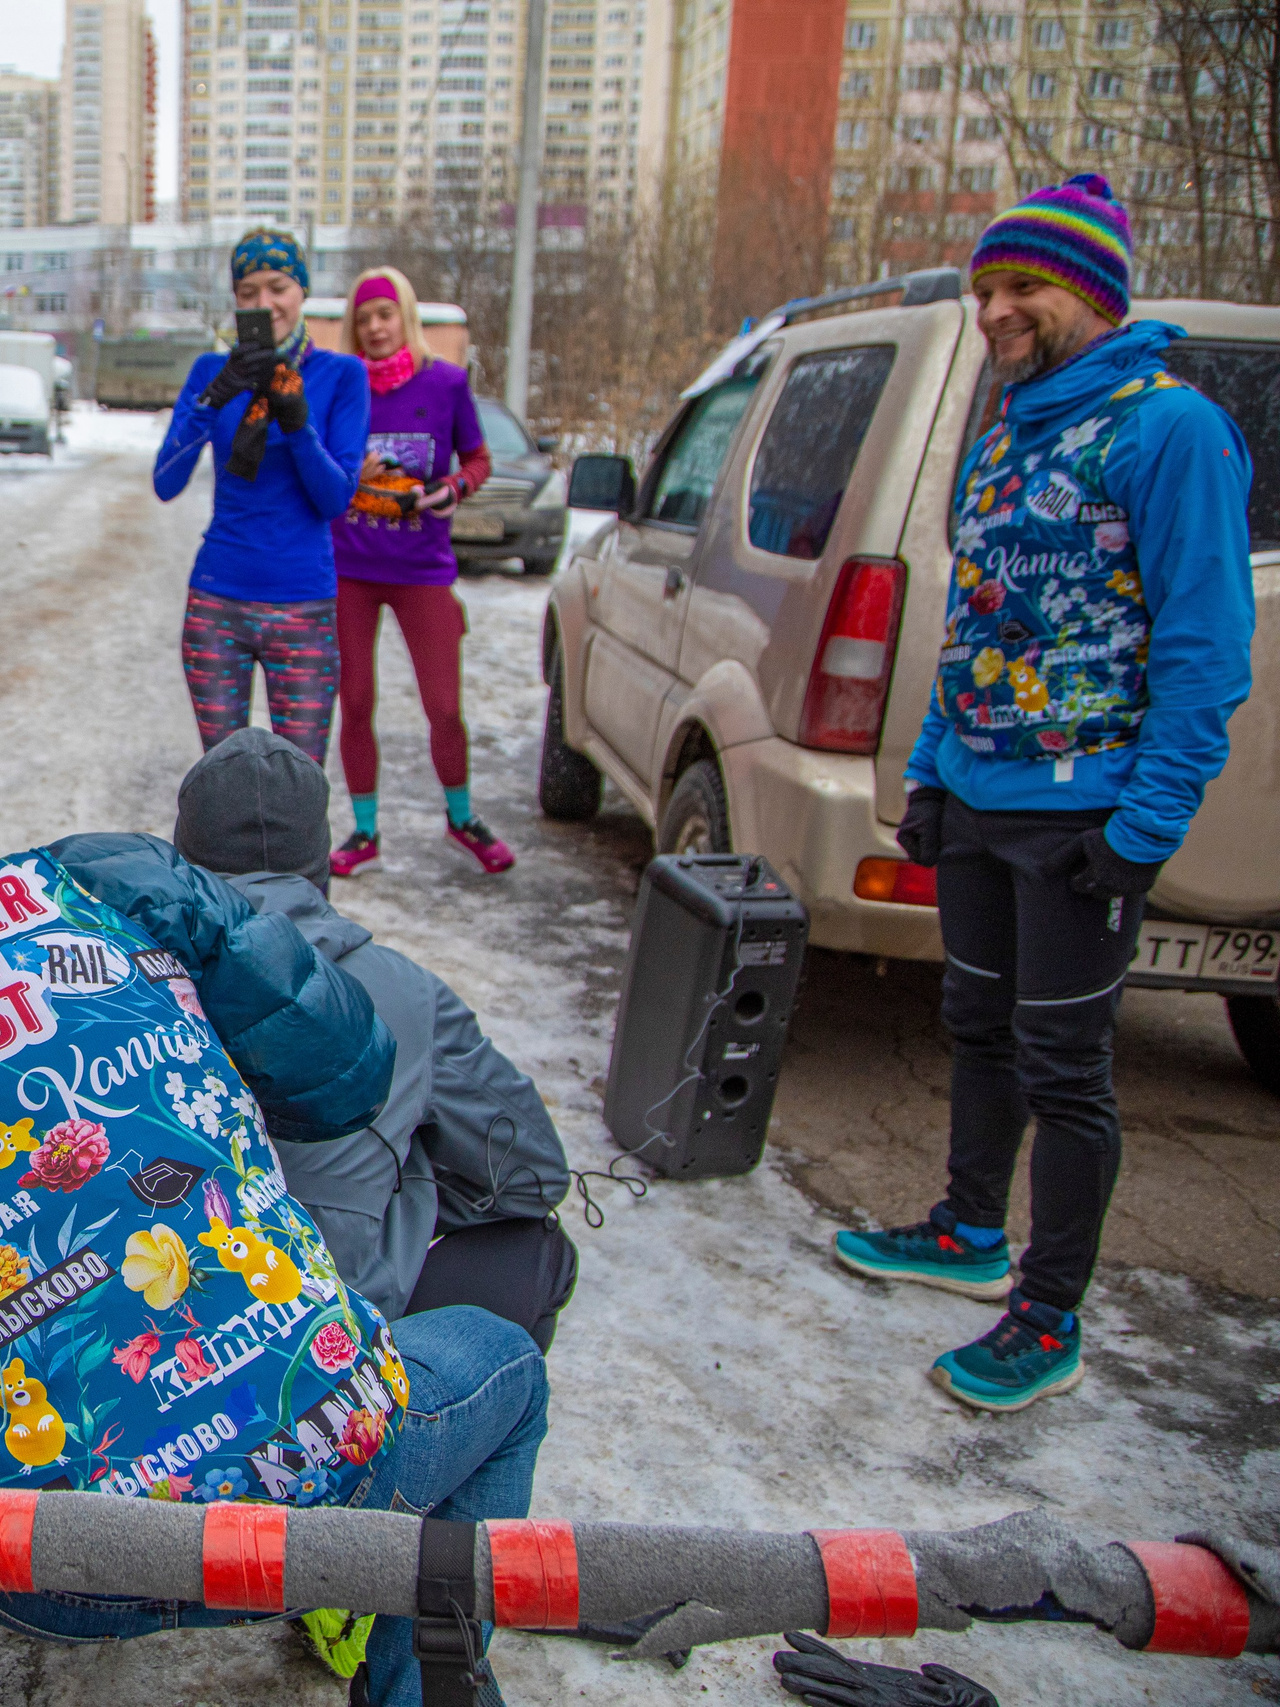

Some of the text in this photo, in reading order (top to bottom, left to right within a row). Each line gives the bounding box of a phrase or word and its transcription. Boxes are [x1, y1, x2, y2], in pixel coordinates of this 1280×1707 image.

[36, 944, 118, 985] RAIL
[1210, 931, 1274, 964] 799
[18, 1011, 211, 1120] Kannas
[99, 1412, 238, 1498] ЛЫСКОВО
